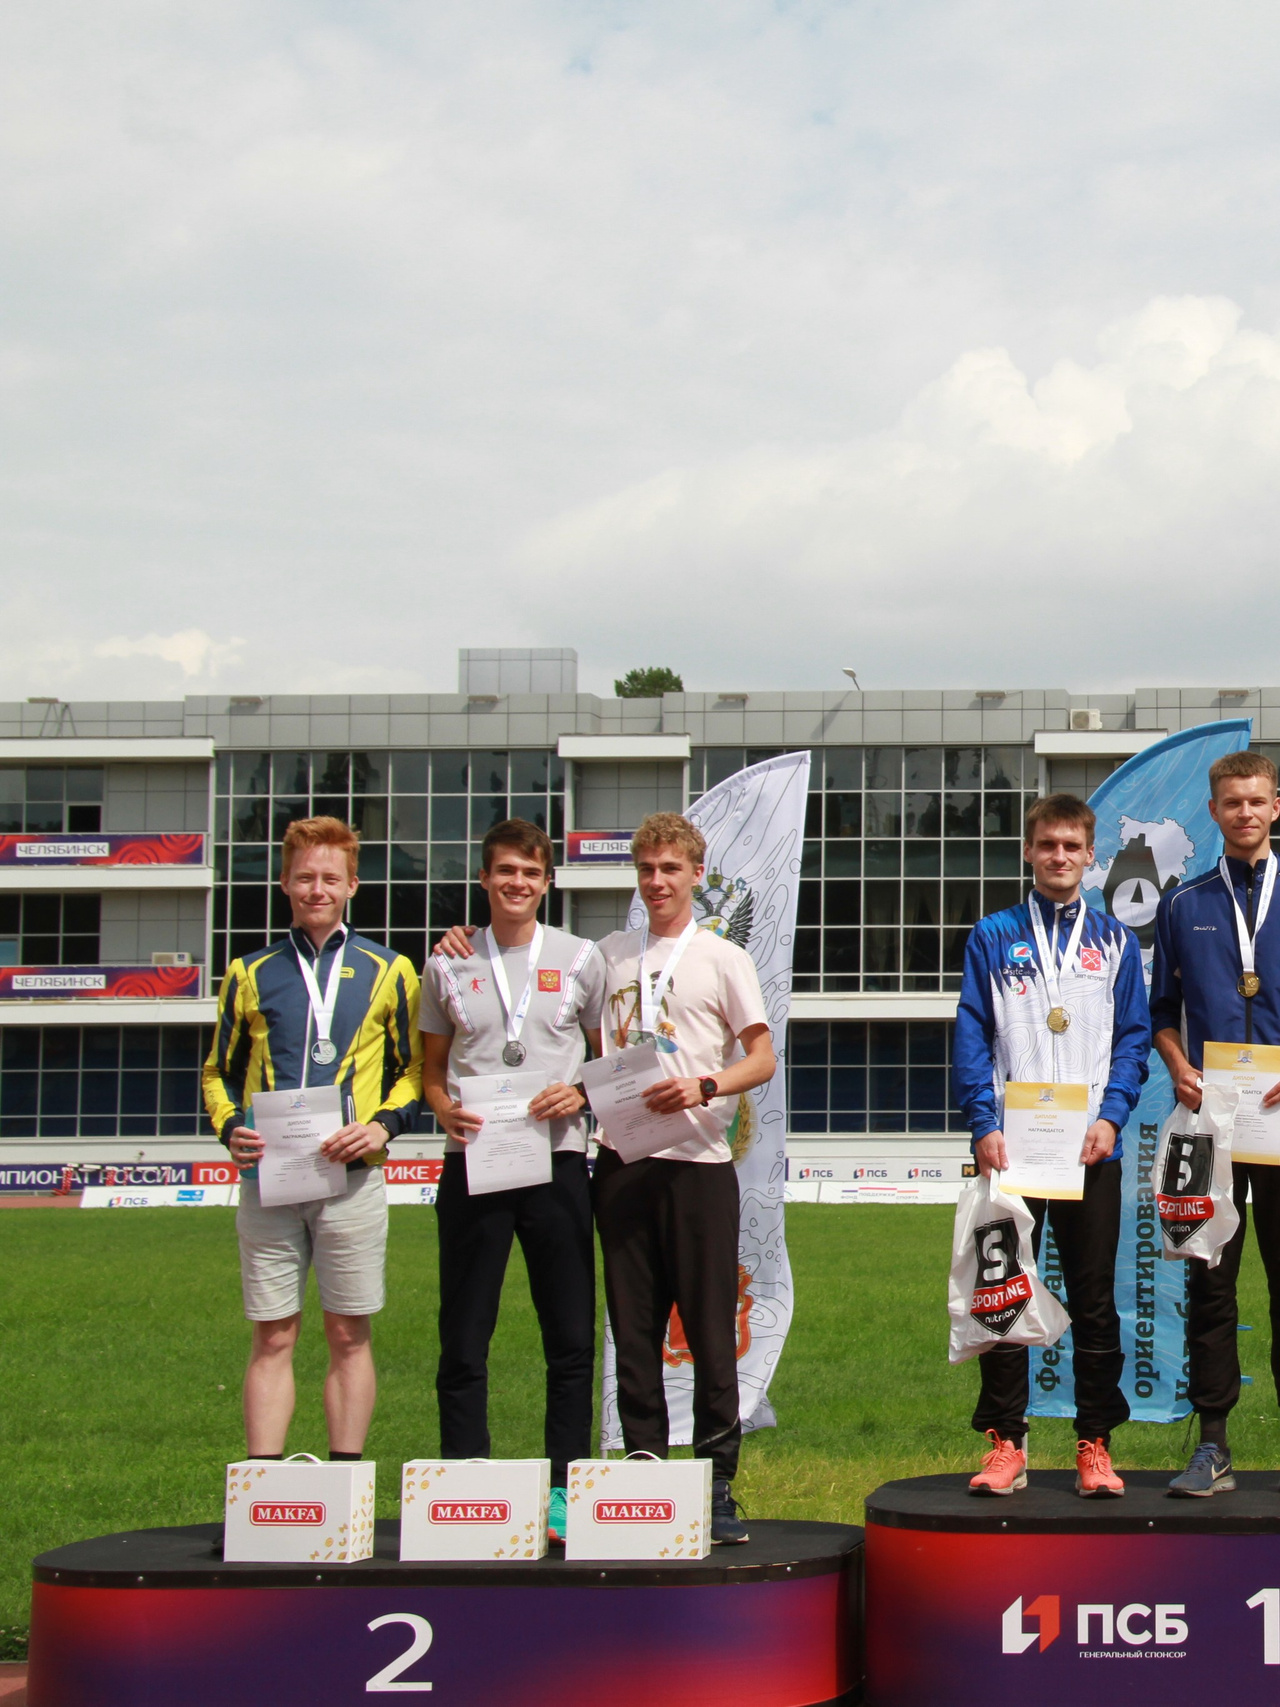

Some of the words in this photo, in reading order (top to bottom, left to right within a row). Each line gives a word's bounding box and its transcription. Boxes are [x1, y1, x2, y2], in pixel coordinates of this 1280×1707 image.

[18, 844, 107, 855] ЧЕЛЯБИНСК
[14, 976, 103, 987] ЧЕЛЯБИНСК
[199, 1168, 230, 1183] ПО
[383, 1165, 429, 1180] ИКЕ
[812, 1169, 834, 1178] ПСБ
[866, 1169, 888, 1178] ПСБ
[921, 1169, 943, 1178] ПСБ
[124, 1197, 148, 1206] ПСБ
[1134, 1122, 1162, 1399] ориентирования
[257, 1507, 319, 1520] MAKFA
[436, 1506, 503, 1519] MAKFA
[601, 1505, 668, 1518] MAKFA
[1077, 1603, 1189, 1645] ПСБ
[1245, 1588, 1280, 1665] 1
[366, 1612, 433, 1692] 2
[1079, 1649, 1142, 1659] ГЕНЕРАЛЬНЫЙ
[1144, 1650, 1187, 1658] СПОНСОР
